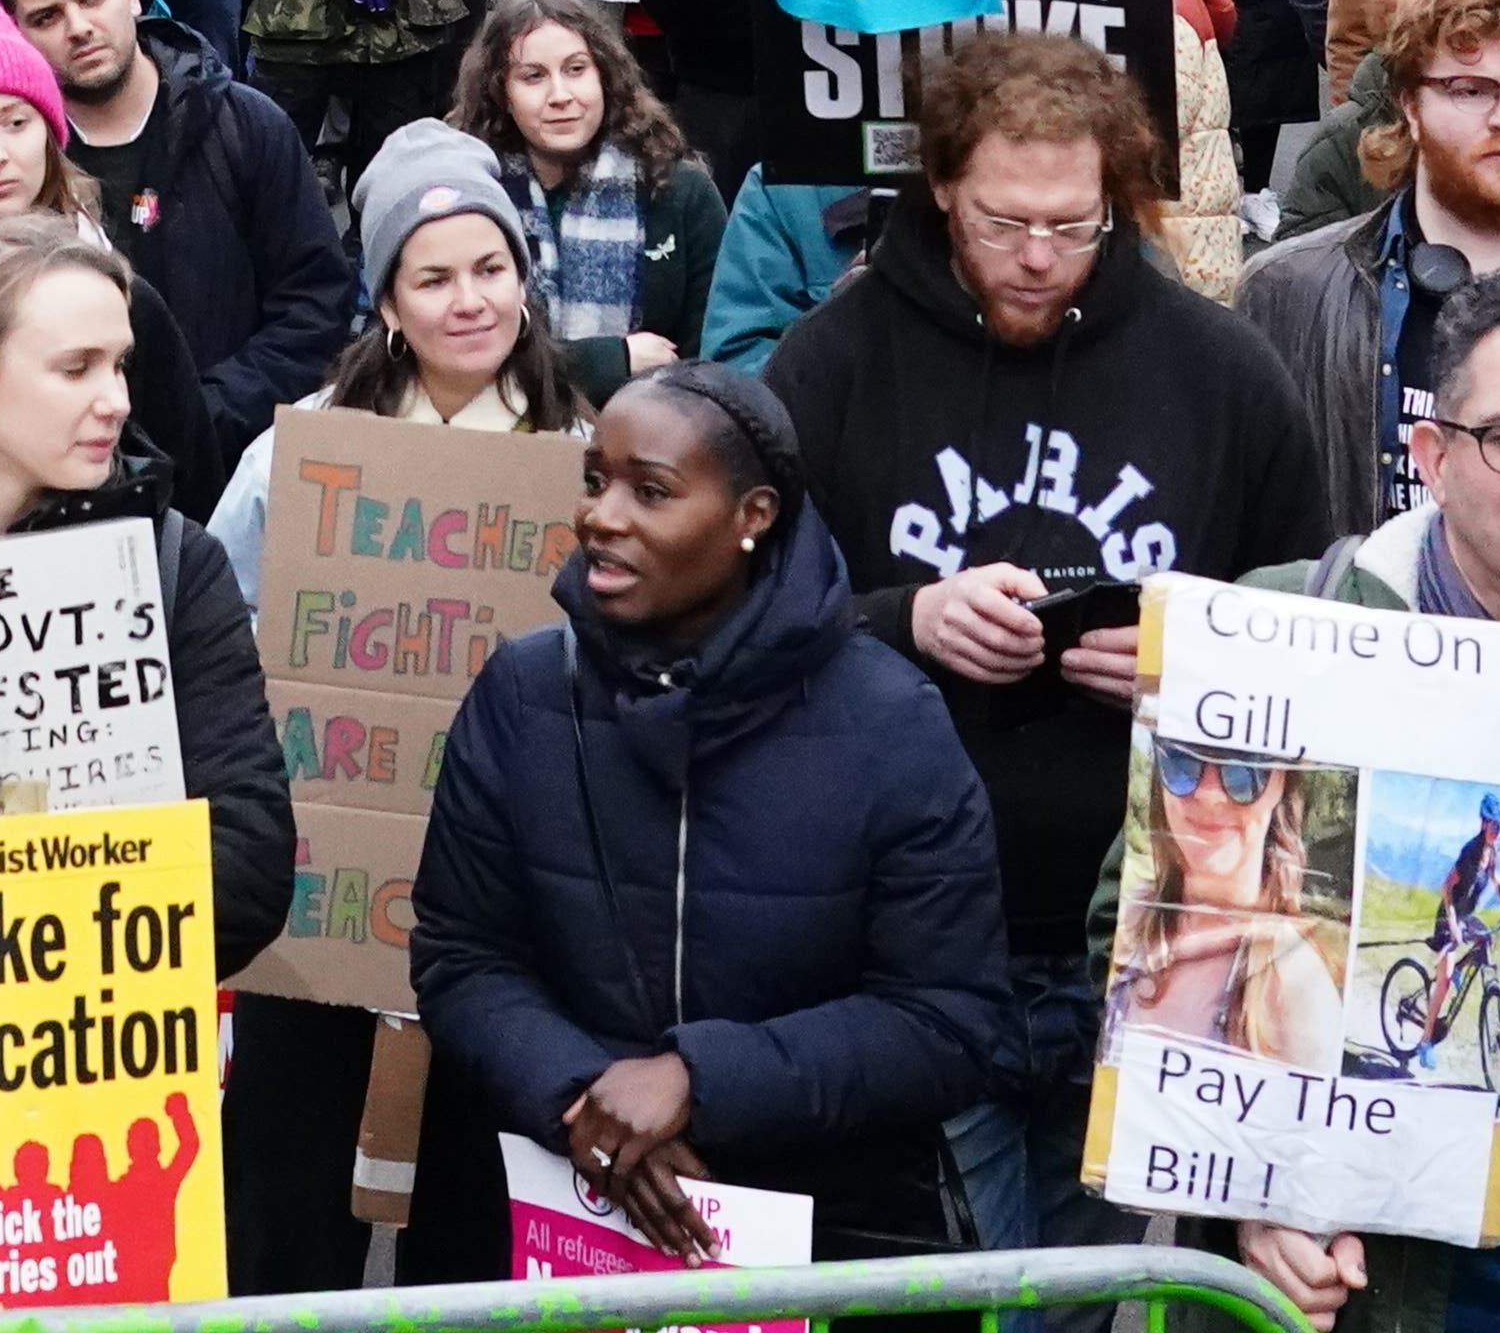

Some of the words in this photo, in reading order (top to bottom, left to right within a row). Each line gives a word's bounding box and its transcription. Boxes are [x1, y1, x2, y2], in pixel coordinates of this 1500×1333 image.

[890, 423, 1177, 582] PARIS
[1044, 567, 1096, 577] SAISON
[1205, 588, 1380, 660] Come
[1404, 619, 1482, 675] On
[1194, 691, 1307, 760] Gill,
[41, 832, 152, 870] Worker
[93, 882, 194, 974] for
[1156, 1049, 1264, 1124] Pay
[1289, 1071, 1396, 1135] The
[52, 1195, 101, 1236] the
[67, 1242, 118, 1283] out
